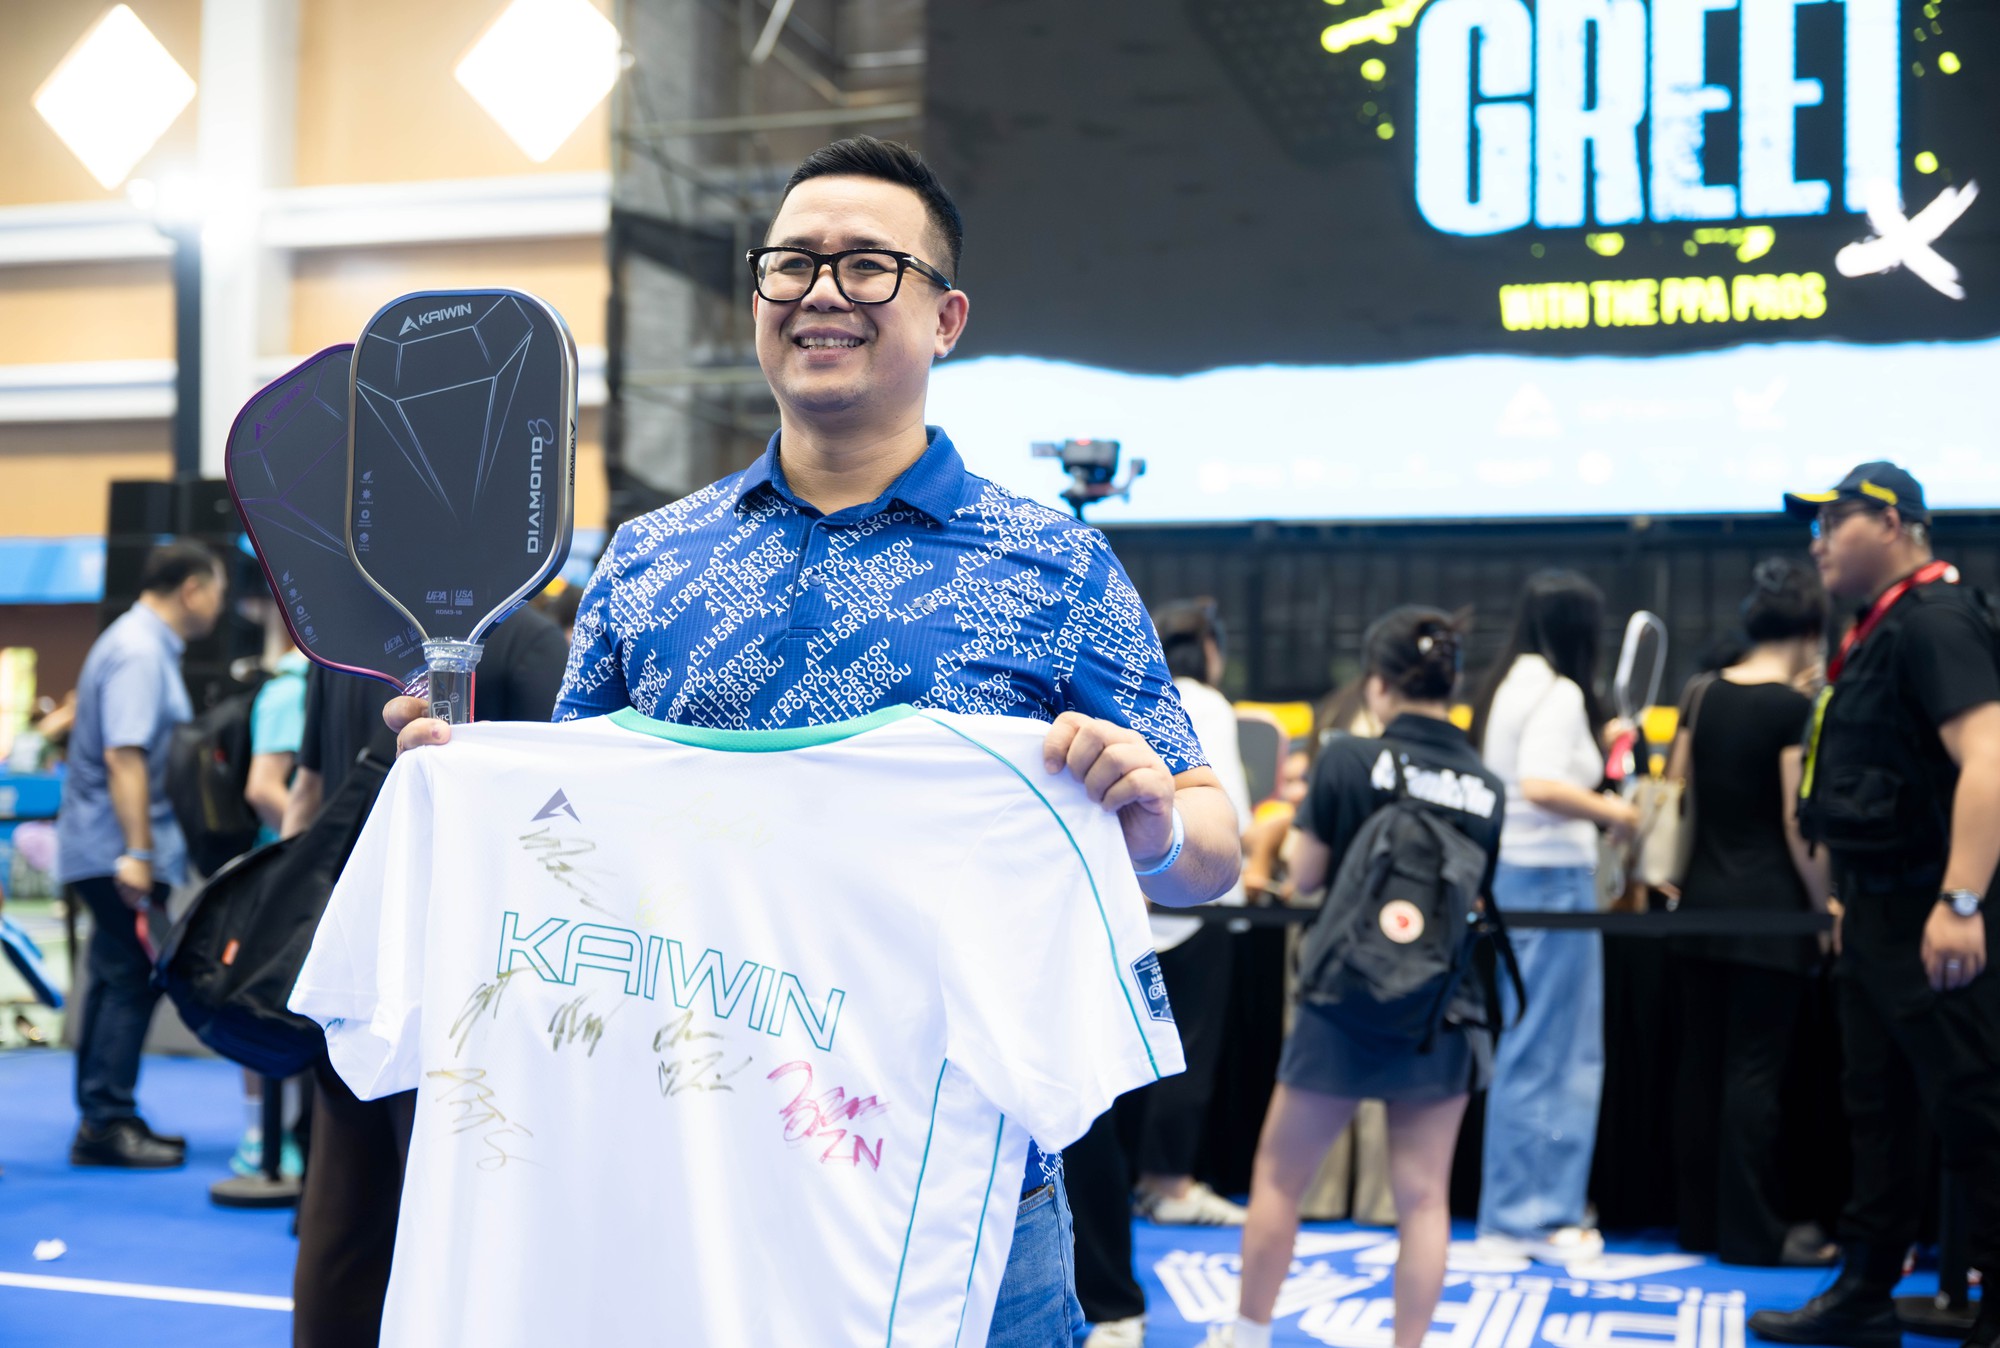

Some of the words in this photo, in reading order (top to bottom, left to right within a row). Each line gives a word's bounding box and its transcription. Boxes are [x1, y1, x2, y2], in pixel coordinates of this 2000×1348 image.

[418, 302, 472, 326] KAIWIN
[1499, 281, 1589, 331] WITH
[1589, 278, 1659, 327] THE
[1731, 272, 1827, 321] PROS
[498, 911, 845, 1052] KAIWIN
